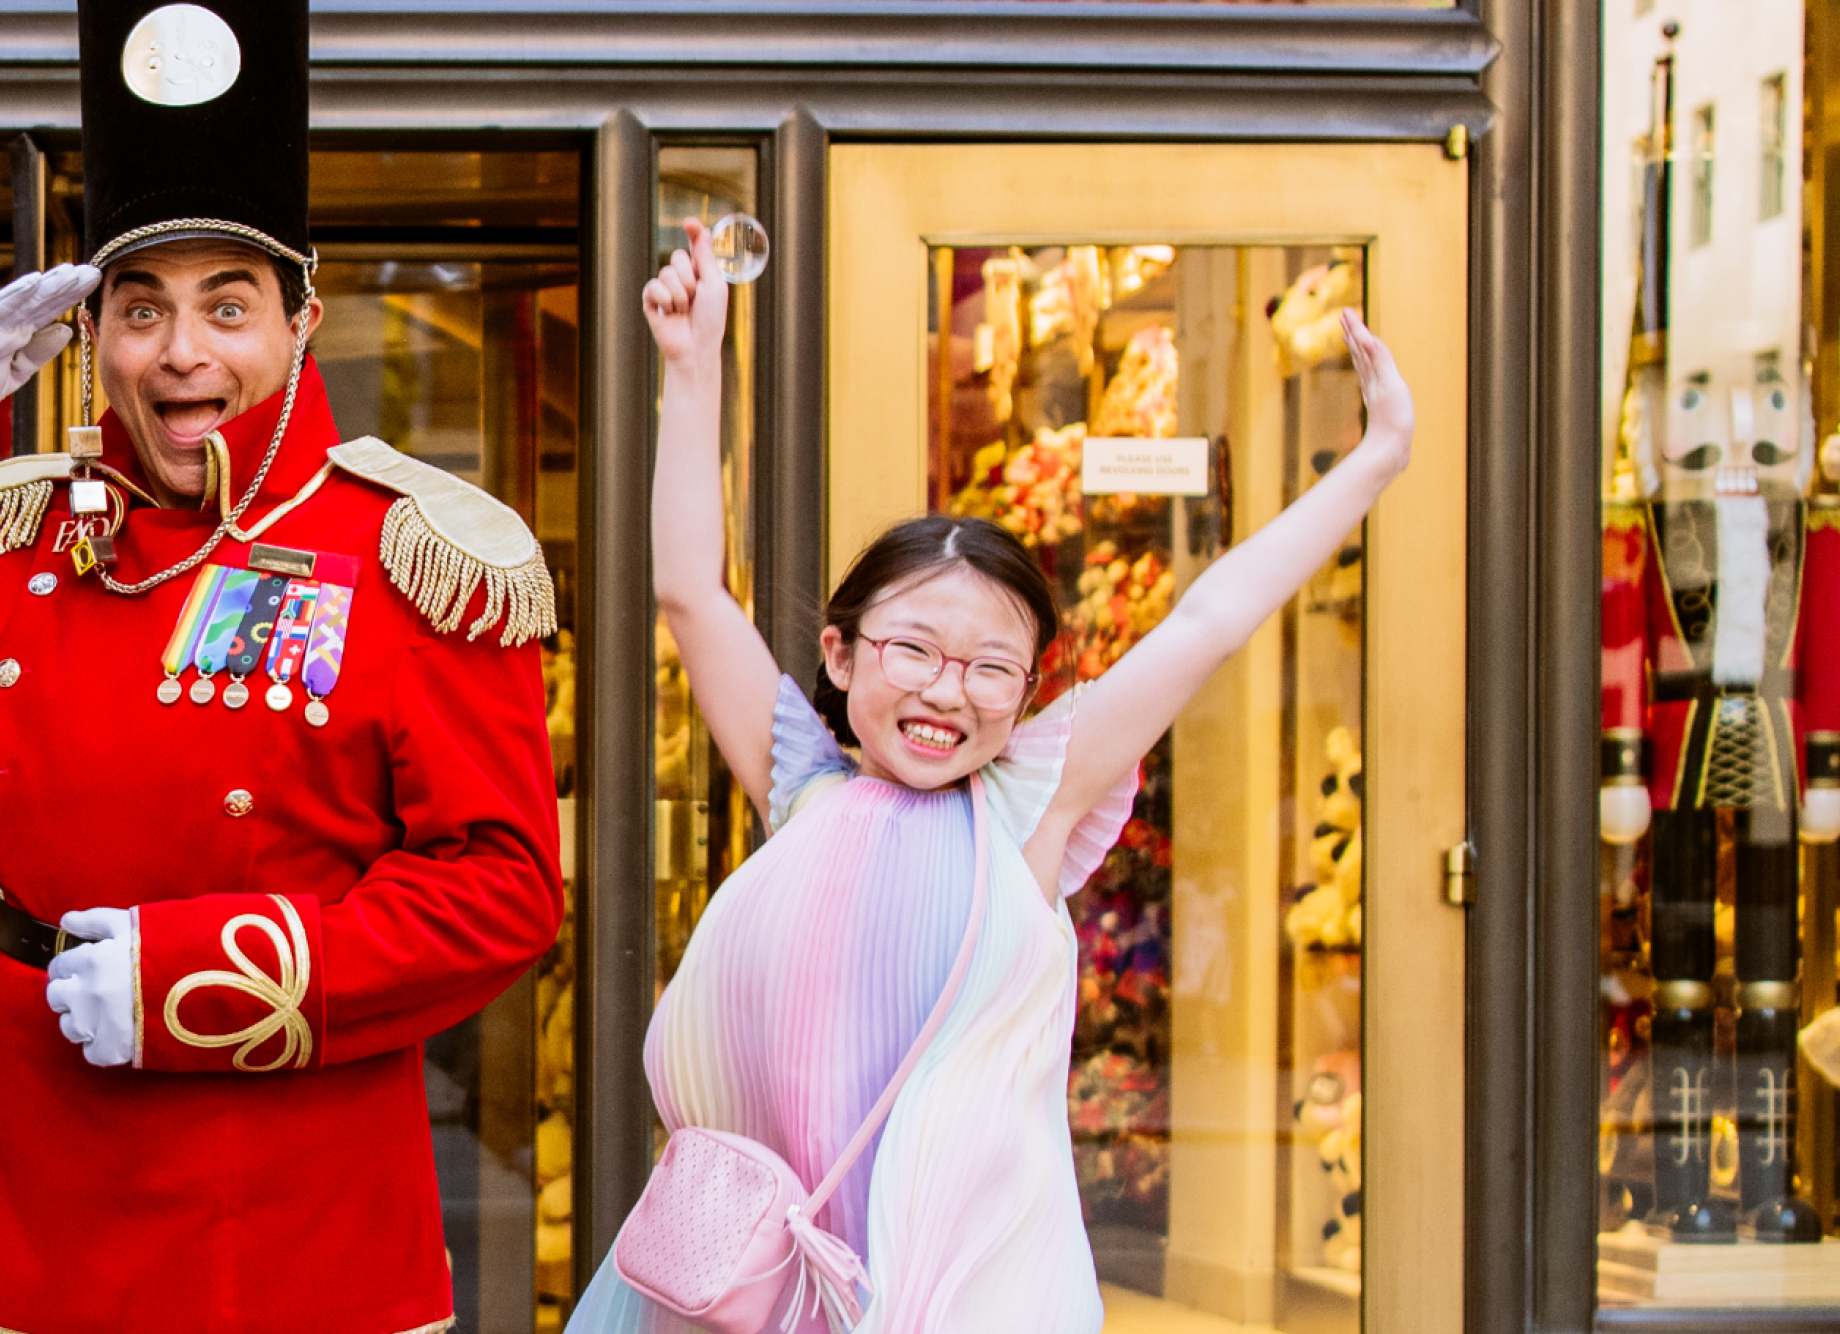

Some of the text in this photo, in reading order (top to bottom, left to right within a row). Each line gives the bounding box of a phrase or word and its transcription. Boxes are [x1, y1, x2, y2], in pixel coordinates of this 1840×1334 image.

[1116, 453, 1173, 464] PLEASE USE
[1098, 464, 1191, 476] REVOLVING DOORS
